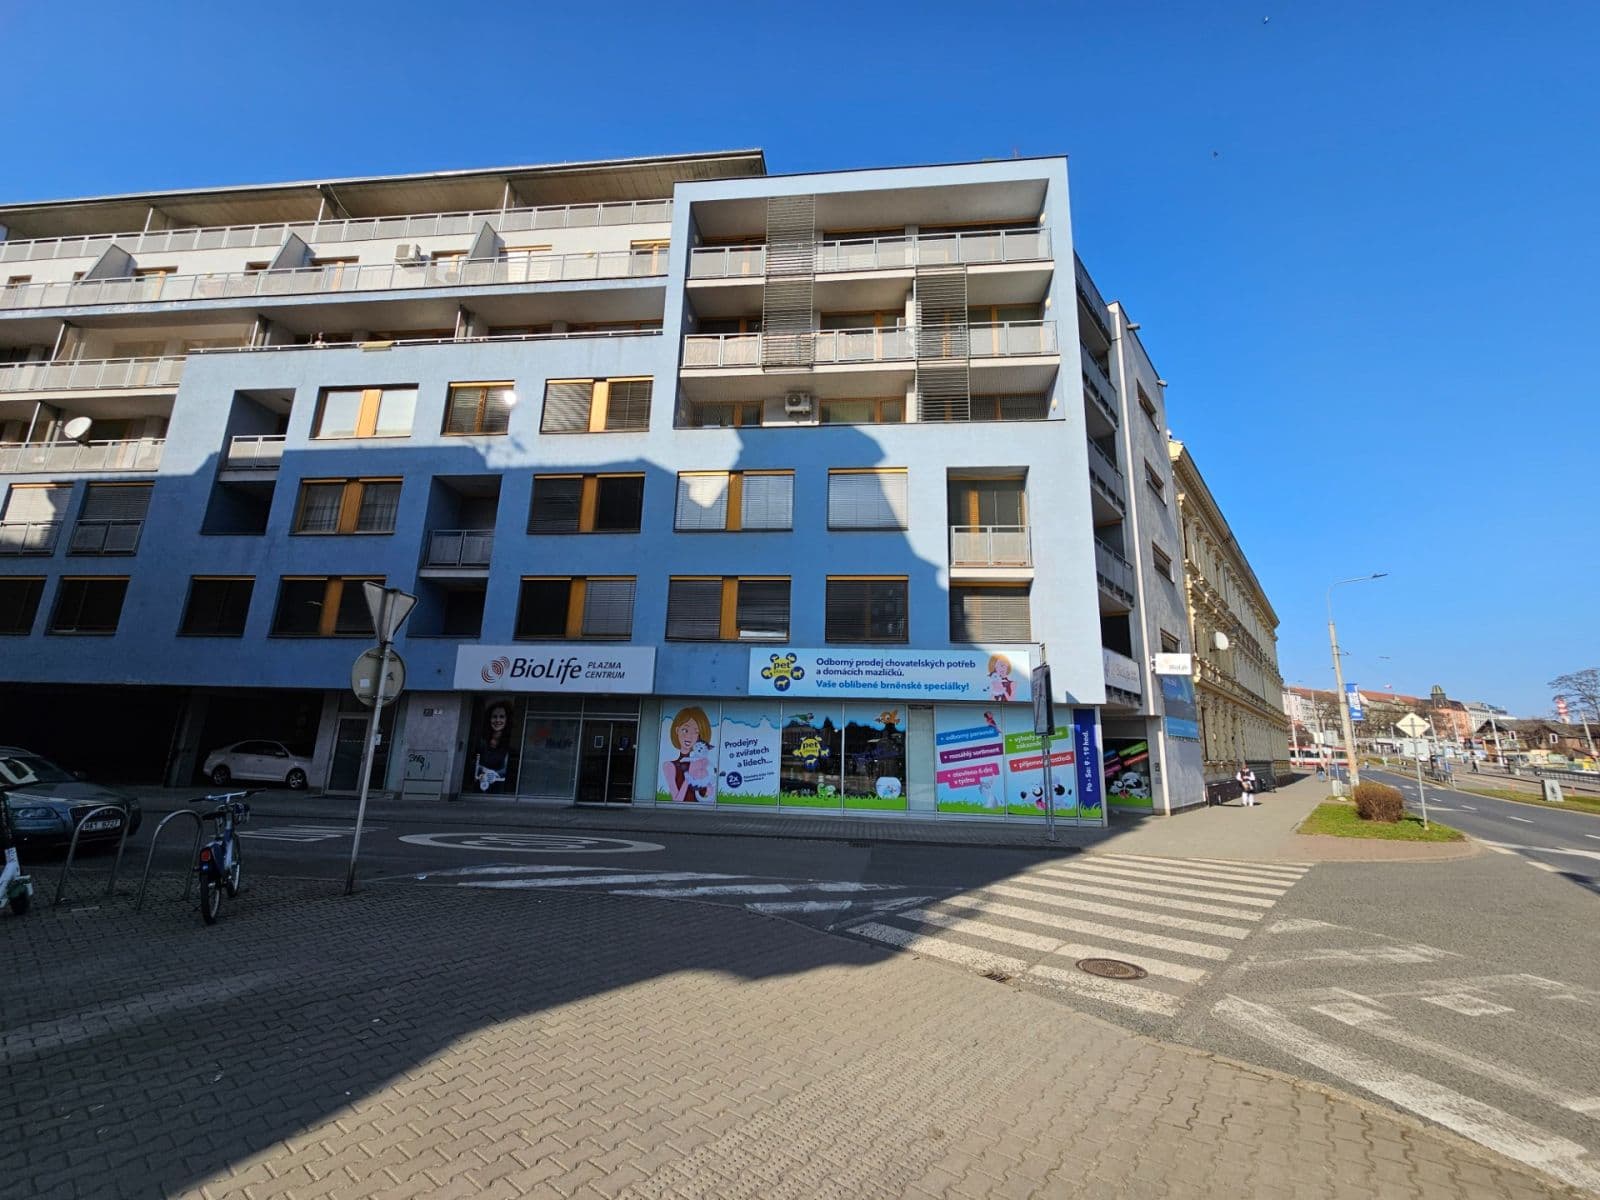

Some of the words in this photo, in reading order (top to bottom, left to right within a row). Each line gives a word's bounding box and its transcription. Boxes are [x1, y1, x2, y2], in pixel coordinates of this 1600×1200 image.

[587, 661, 622, 670] PLAZMA
[773, 662, 791, 670] pet
[816, 657, 854, 668] Odborný
[855, 658, 884, 668] prodej
[885, 658, 945, 669] chovatelských
[946, 659, 976, 669] potřeb
[510, 657, 582, 685] BioLife
[585, 671, 625, 680] CENTRUM
[823, 667, 863, 675] domácích
[816, 679, 837, 688] Vaše
[838, 679, 878, 689] oblíbené
[881, 680, 922, 690] brněnské
[924, 681, 970, 692] speciálky!
[724, 738, 758, 749] Prodejny
[736, 746, 770, 758] zvířatech
